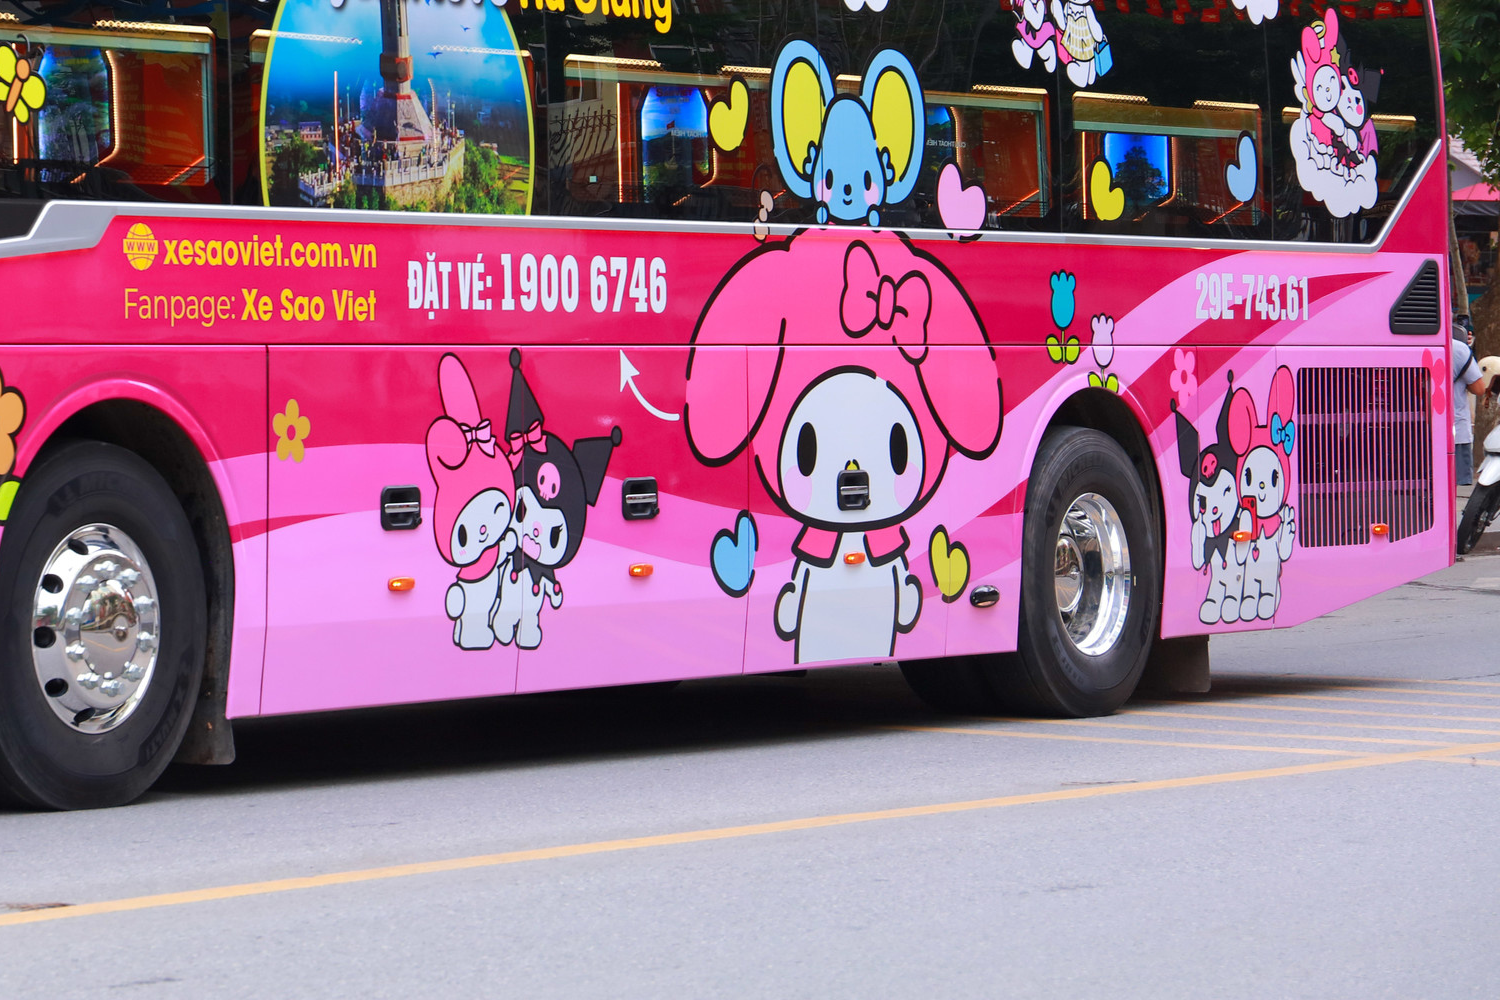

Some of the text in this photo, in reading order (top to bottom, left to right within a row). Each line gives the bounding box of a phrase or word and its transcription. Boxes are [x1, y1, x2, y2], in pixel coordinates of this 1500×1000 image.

[163, 234, 377, 268] xesaoviet.com.vn
[124, 288, 377, 327] Fanpage: Xe Sao Viet
[407, 251, 668, 320] ĐẶT VÉ: 1900 6746
[1195, 272, 1309, 321] 29E-743.61
